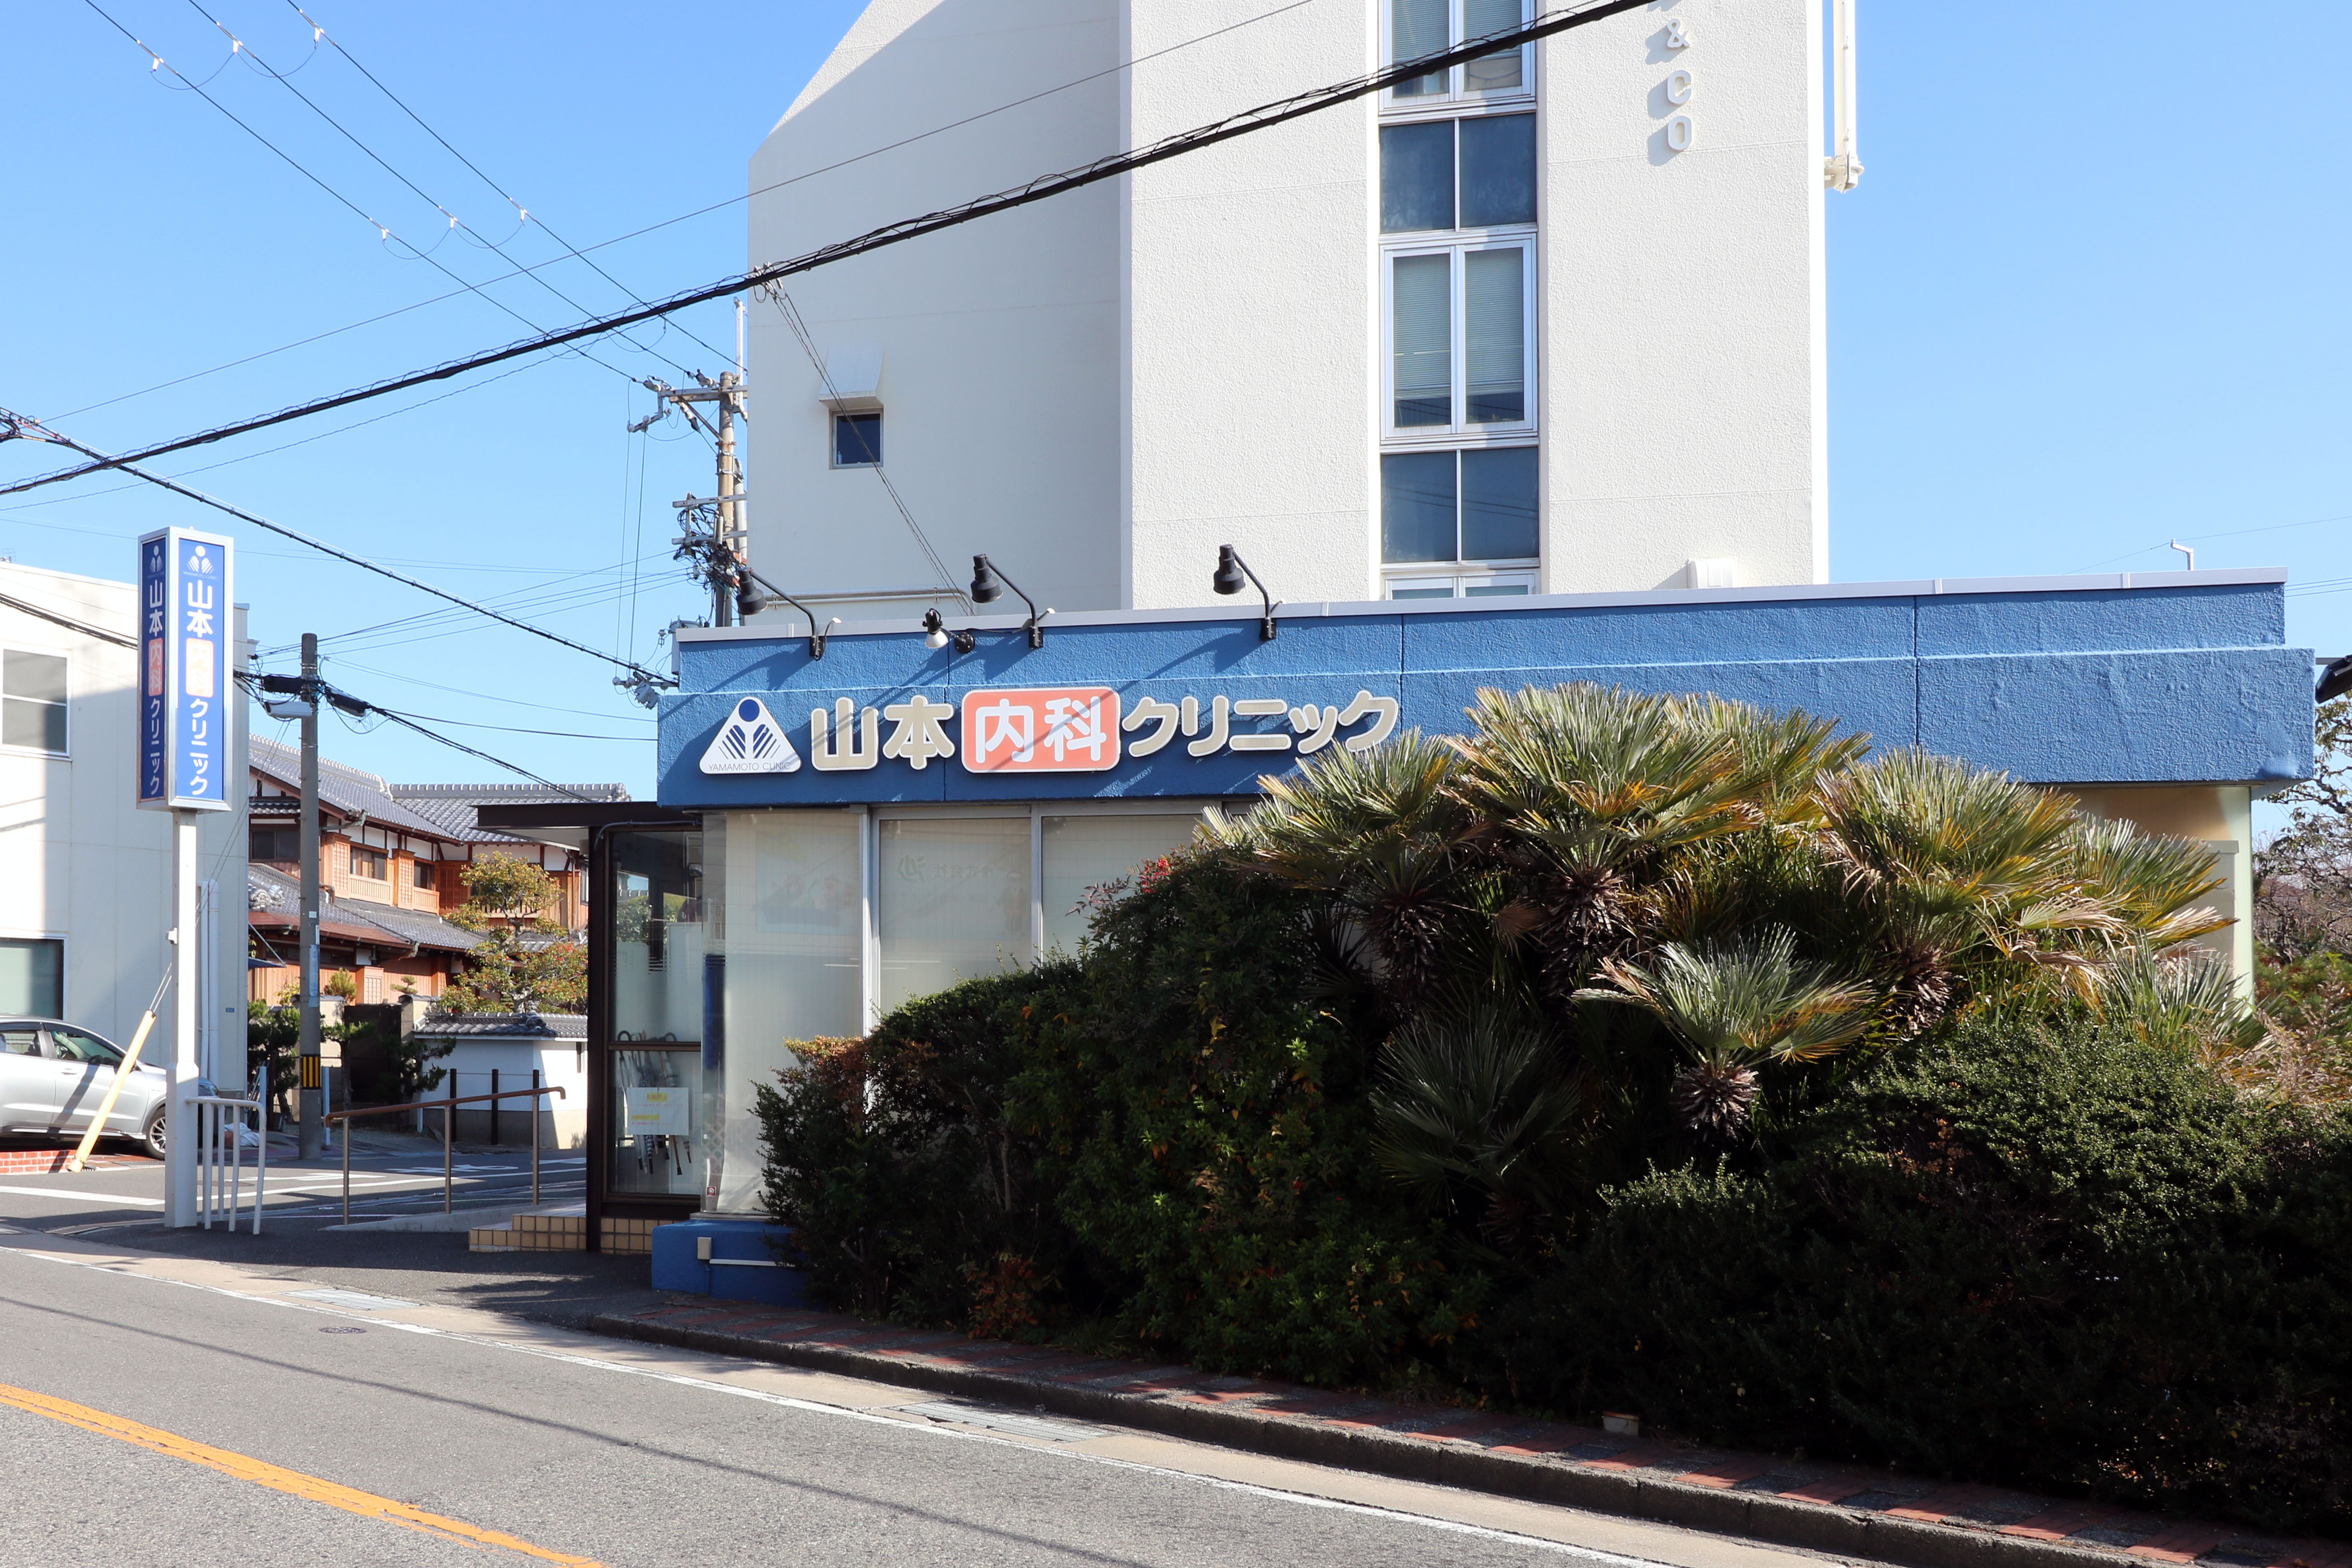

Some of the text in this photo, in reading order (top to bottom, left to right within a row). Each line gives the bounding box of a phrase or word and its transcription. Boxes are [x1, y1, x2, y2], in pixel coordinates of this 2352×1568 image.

[1667, 19, 1692, 151] & CO
[149, 579, 163, 795] 山本内科クリニック
[811, 690, 1399, 771] 山本内科クリニック
[708, 762, 791, 772] YAMAMOTO CLINIC
